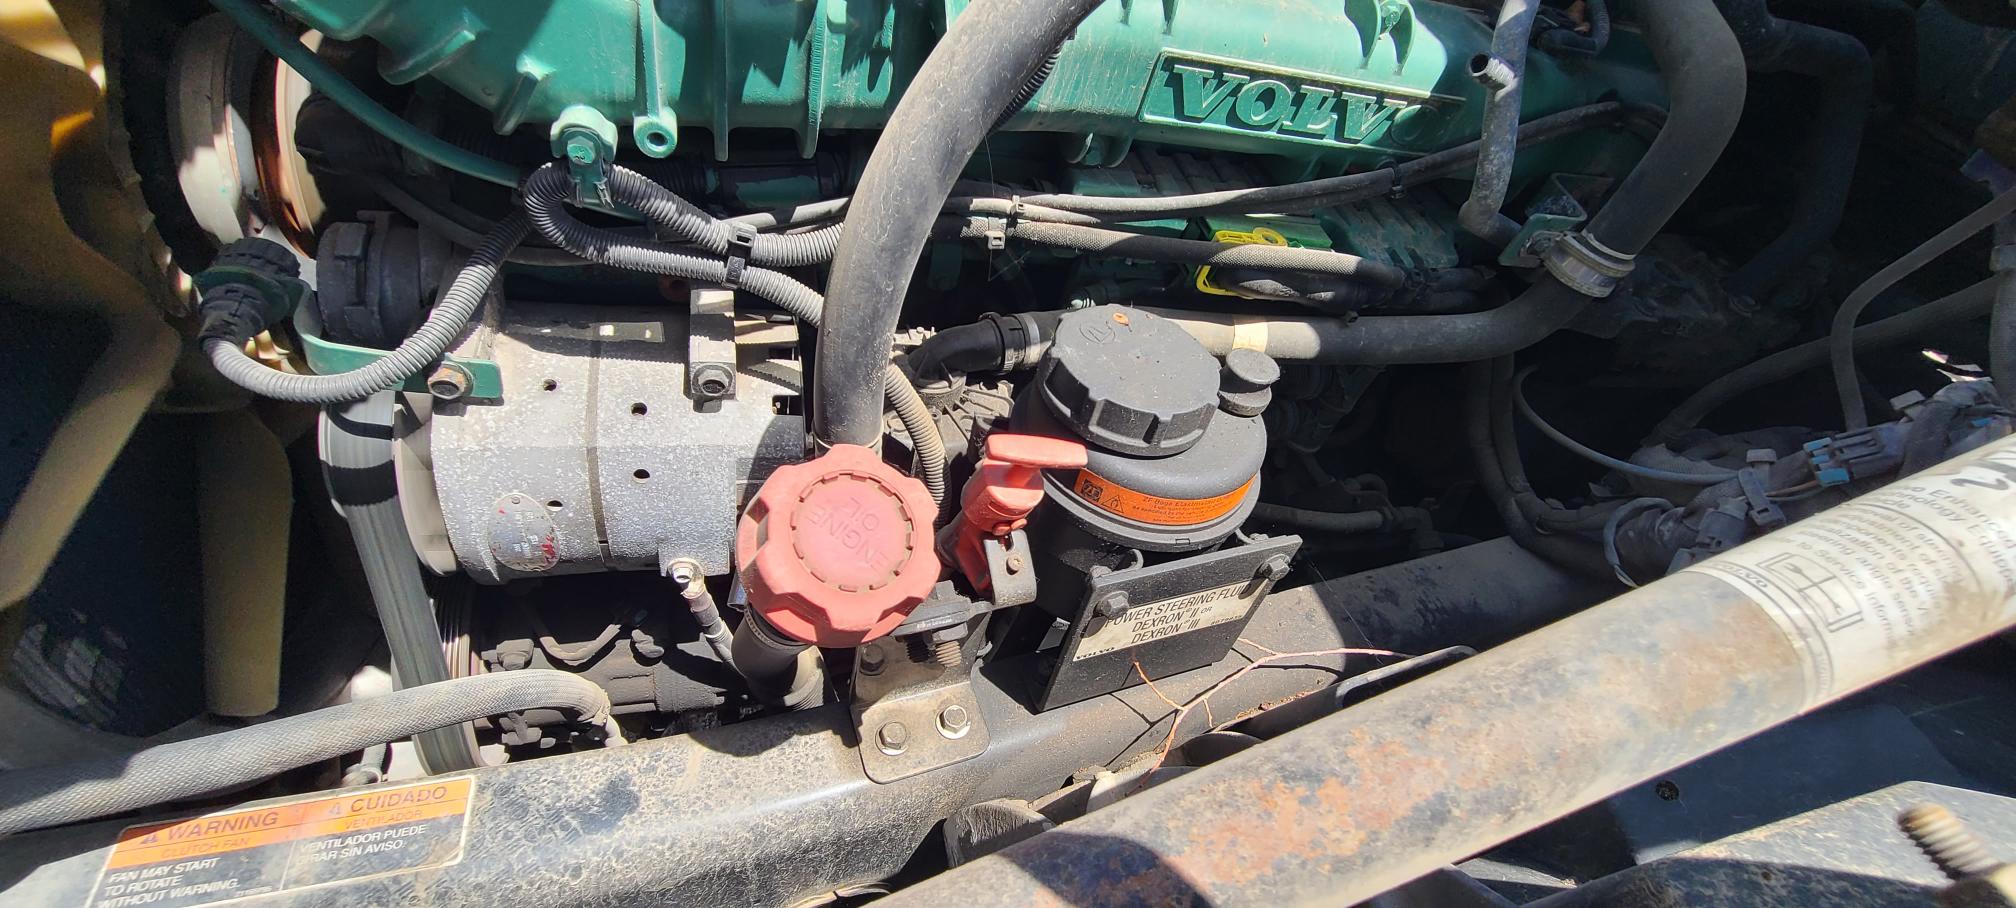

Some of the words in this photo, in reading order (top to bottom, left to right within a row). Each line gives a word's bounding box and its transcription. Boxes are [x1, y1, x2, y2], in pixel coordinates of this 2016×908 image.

[1172, 64, 1443, 146] VOLVO
[848, 496, 880, 532] OIL
[807, 504, 889, 574] ENGINE
[1807, 548, 1873, 591] Service
[1155, 591, 1217, 616] STEERING
[1216, 583, 1251, 600] FLUID
[1201, 606, 1213, 614] OR
[351, 786, 448, 813] CUIDADO
[167, 812, 279, 841] WARNING
[345, 810, 422, 830] VENTILADOR
[161, 840, 219, 859] CLUTCH
[220, 837, 250, 851] FAN
[300, 832, 381, 851] VENTILADOR
[383, 824, 428, 839] PUEDE
[339, 845, 363, 859] SIN
[108, 870, 140, 883] FAN
[140, 864, 174, 879] MAY
[173, 857, 222, 874] START
[98, 889, 169, 908] WITHOUT
[169, 878, 240, 898] WARNING.
[104, 884, 125, 897] TO
[126, 874, 184, 894] ROTATE
